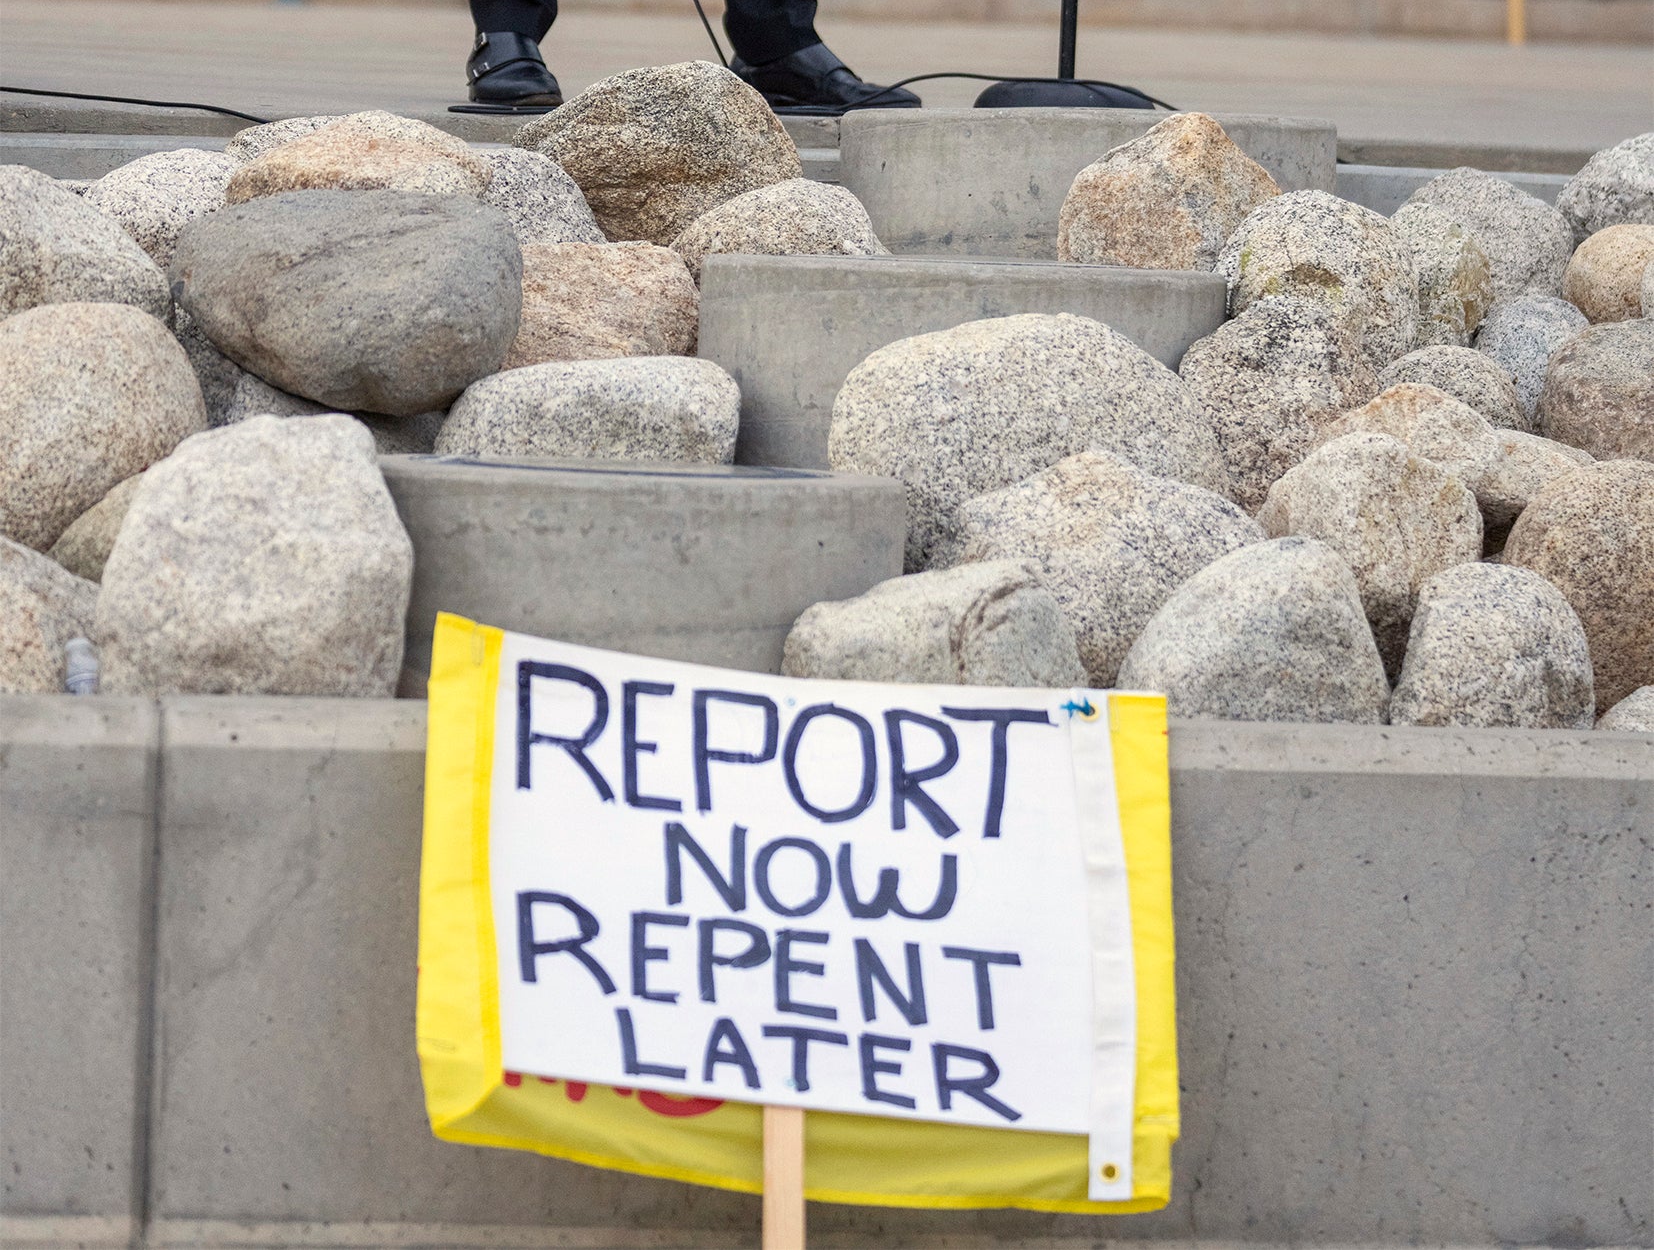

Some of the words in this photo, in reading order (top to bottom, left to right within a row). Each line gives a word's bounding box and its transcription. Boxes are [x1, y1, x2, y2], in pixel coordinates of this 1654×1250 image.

[516, 659, 1058, 839] REPORT
[664, 822, 958, 921] NOW
[516, 890, 1022, 1031] REPENT
[615, 1007, 1023, 1122] LATER
